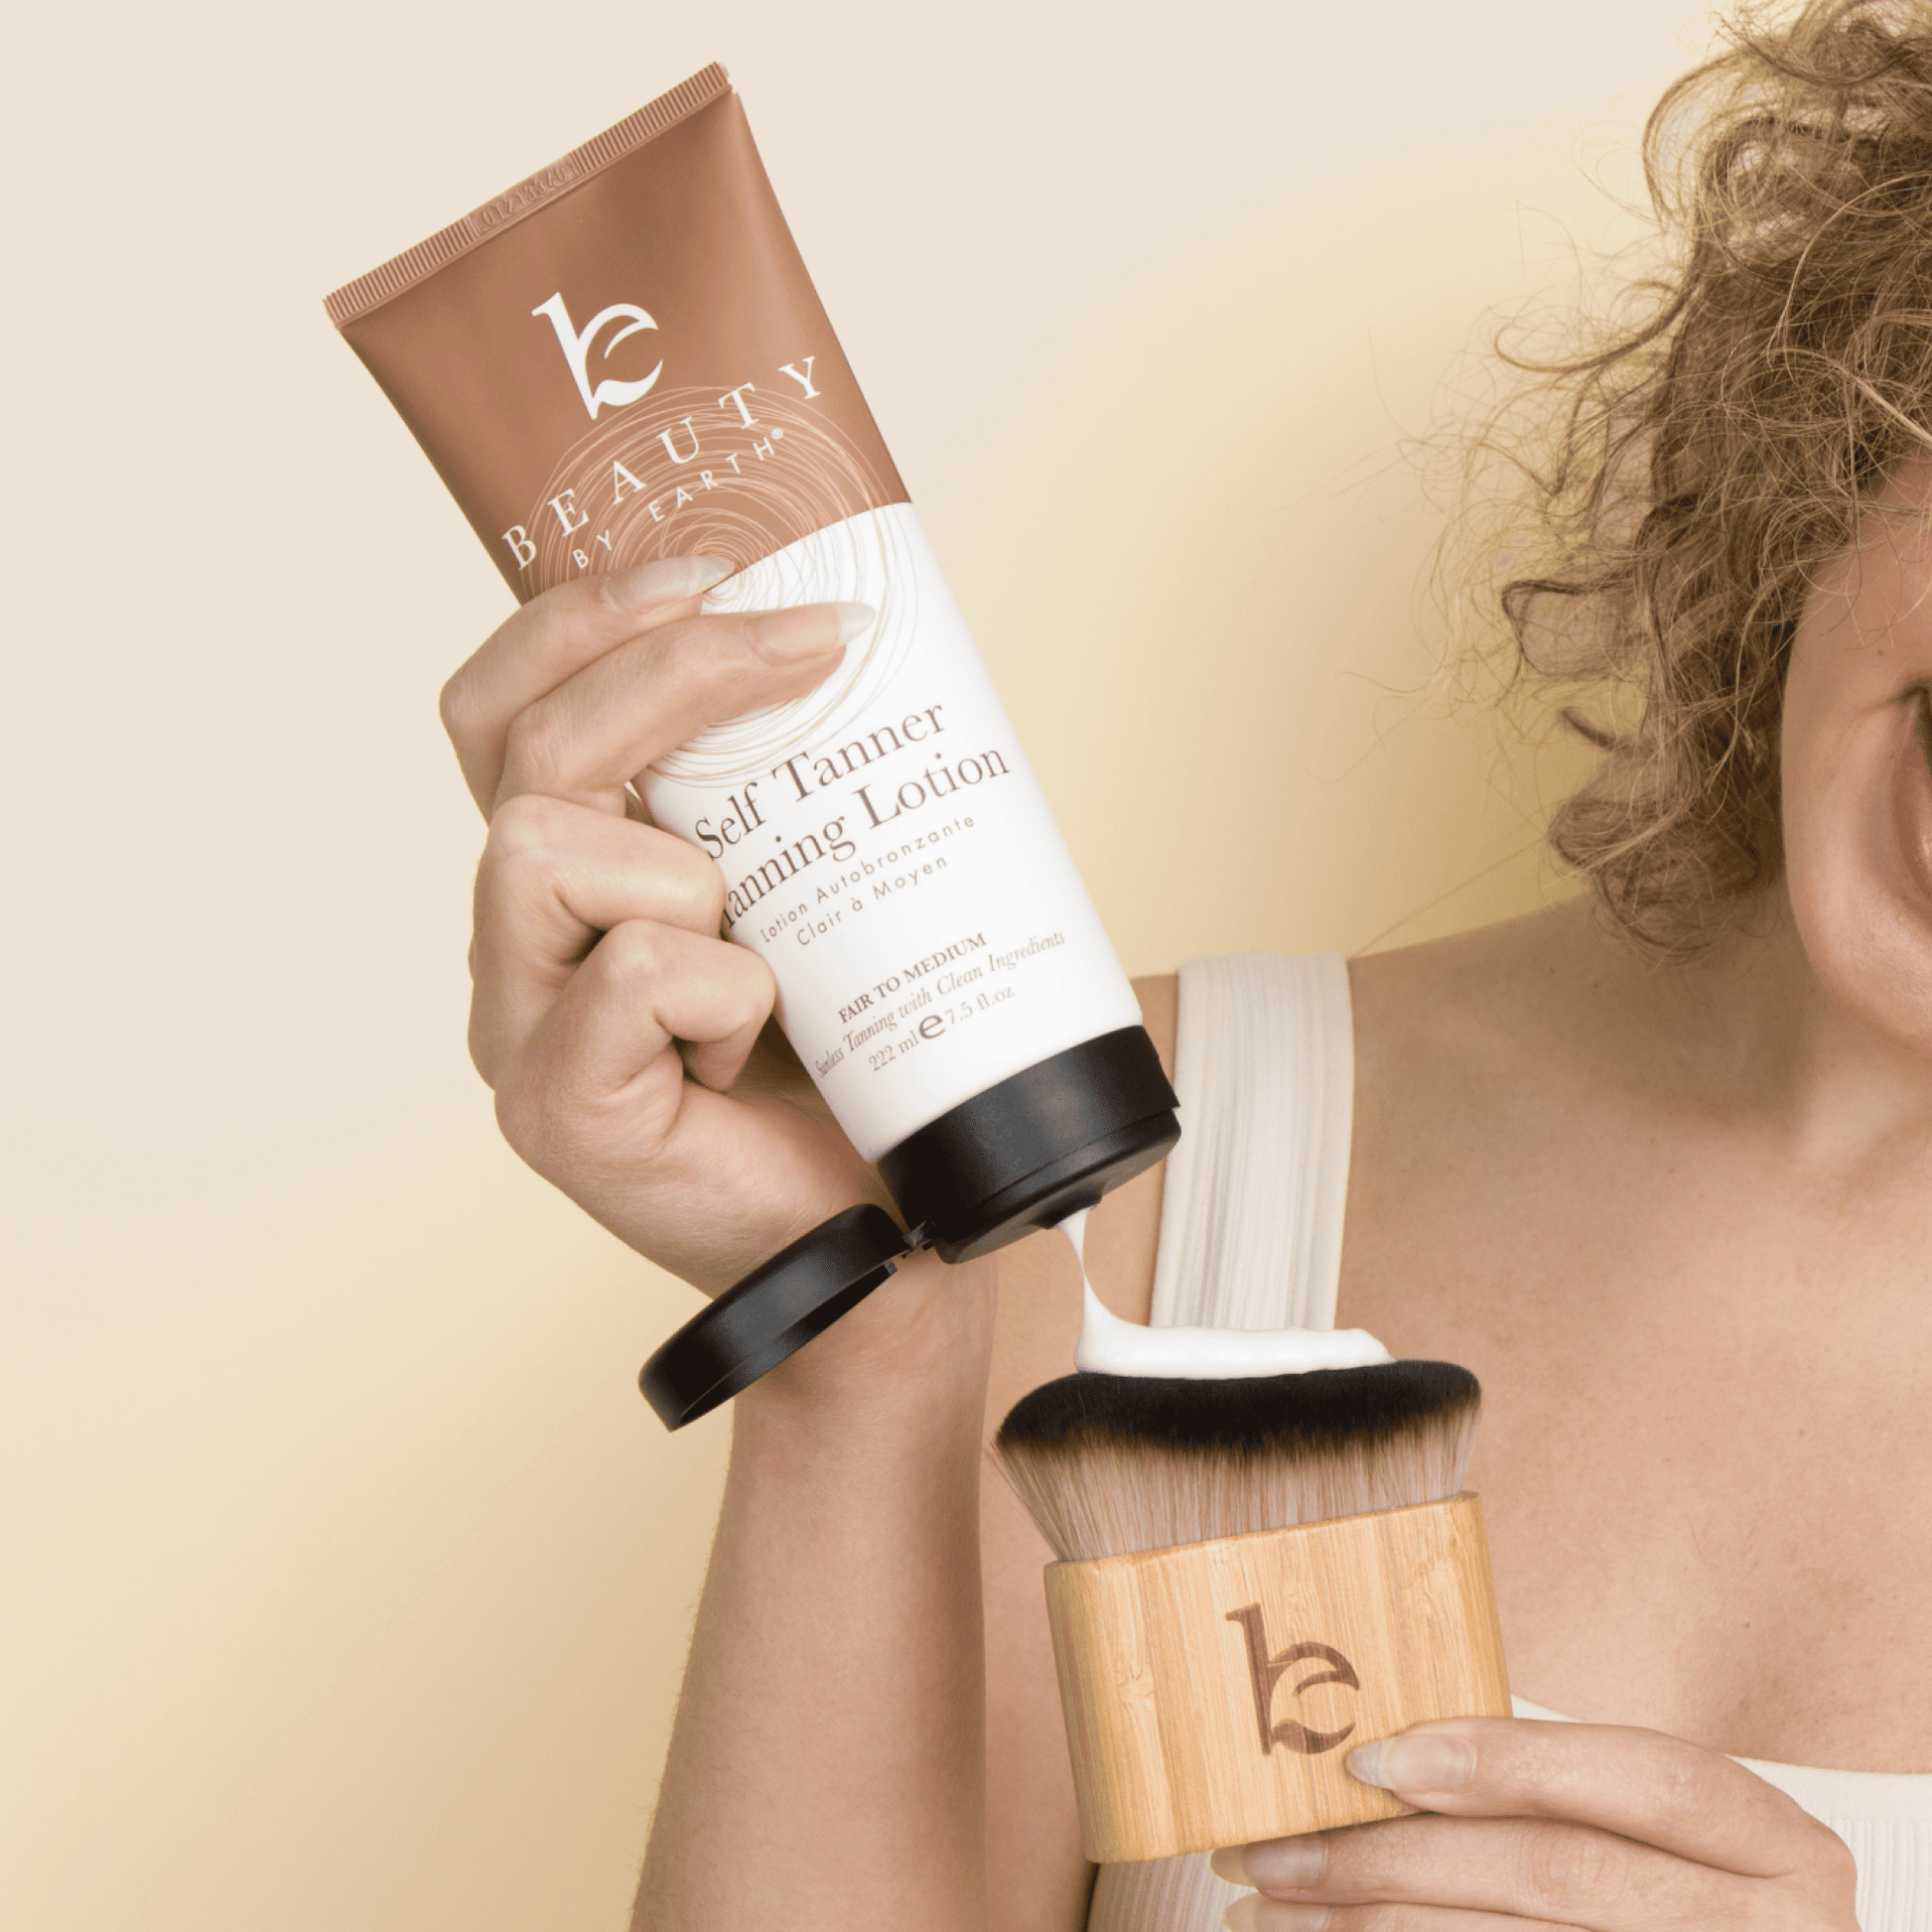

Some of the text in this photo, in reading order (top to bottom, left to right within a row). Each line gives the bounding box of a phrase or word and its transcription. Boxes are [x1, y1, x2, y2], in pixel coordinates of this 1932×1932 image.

[501, 355, 821, 571] BEAUTY
[572, 530, 613, 569] BY
[695, 704, 945, 860] Self Tanner
[853, 749, 1010, 830] Lotion
[759, 815, 976, 943] Lotion Autobronzante
[796, 910, 842, 945] Clair
[872, 858, 948, 900] Moyen
[838, 932, 989, 1024] FAIR TO MEDIUM
[843, 1012, 898, 1052] Tanning
[897, 986, 934, 1020] with
[936, 964, 985, 996] Clean
[988, 931, 1066, 973] Ingredients
[868, 1044, 897, 1072] 222
[944, 1002, 974, 1026] 7.5
